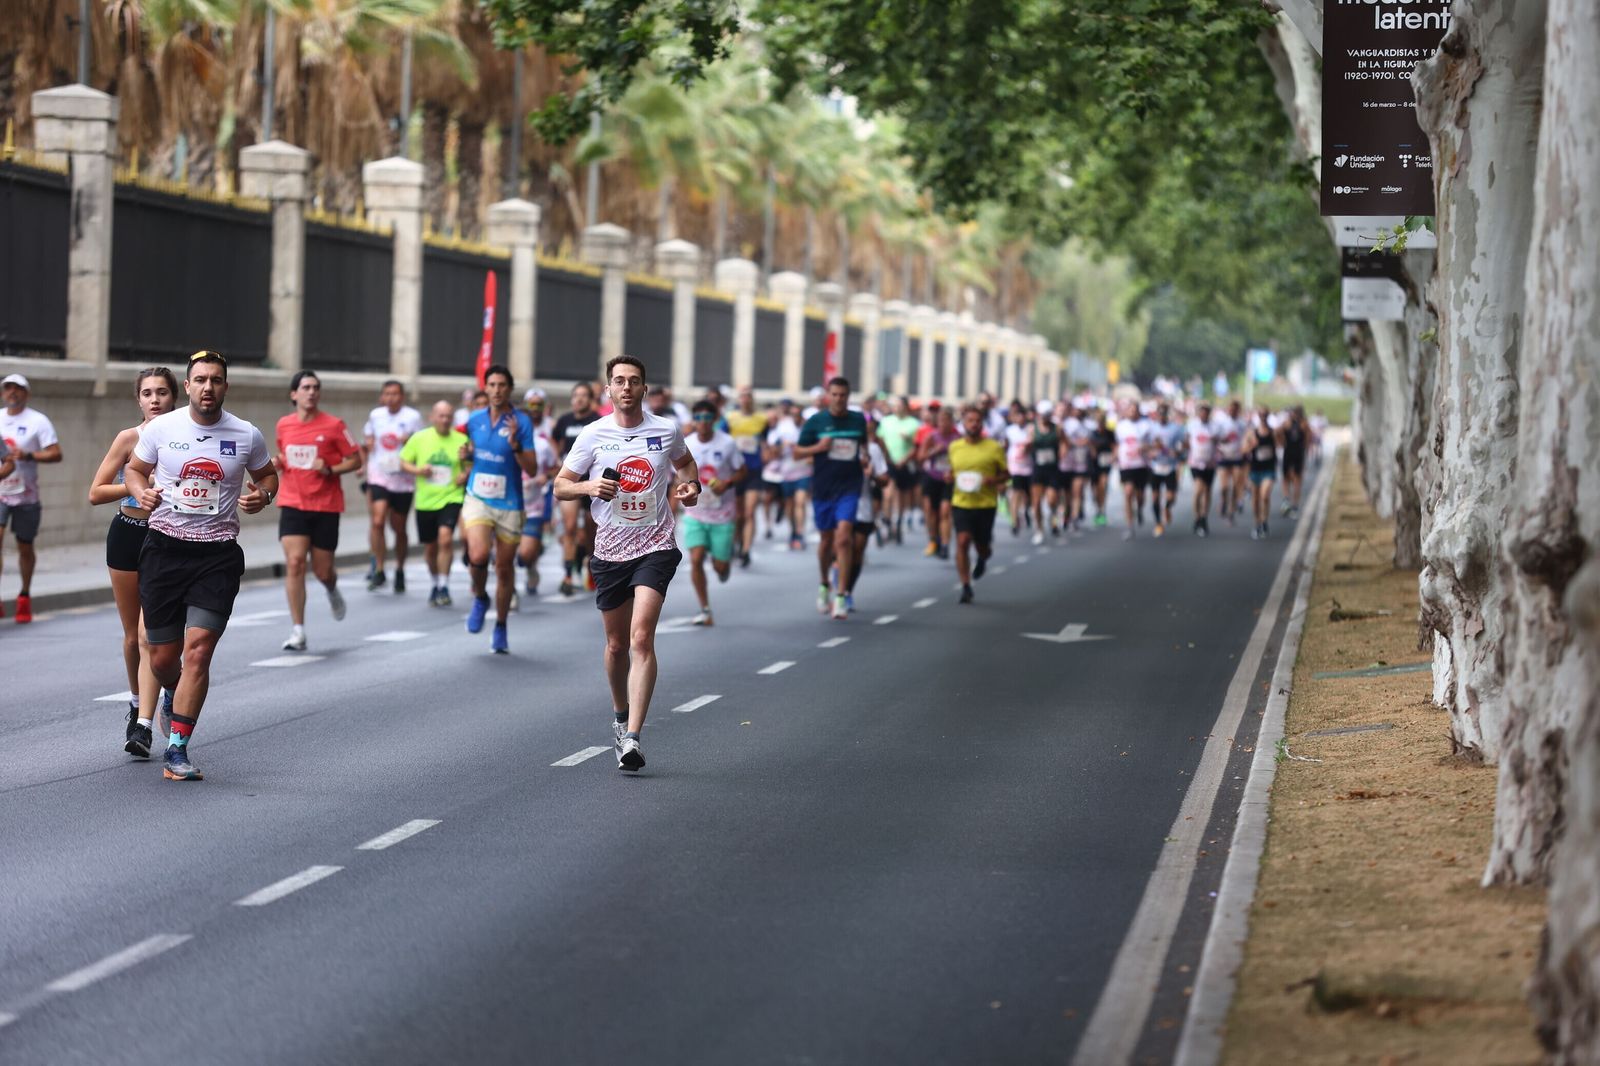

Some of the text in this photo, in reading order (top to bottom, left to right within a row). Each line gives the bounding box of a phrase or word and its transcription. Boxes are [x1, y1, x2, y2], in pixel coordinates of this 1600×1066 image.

[1347, 49, 1419, 57] VANGUARDISTAS
[1422, 49, 1428, 57] Y
[1344, 72, 1395, 80] (1920-1970).
[1350, 154, 1385, 162] Fundación
[1350, 161, 1375, 170] Unicaja
[188, 465, 220, 480] PONLE
[621, 465, 650, 478] PONLE
[620, 473, 648, 485] FRENO
[183, 488, 208, 498] 607
[621, 501, 647, 511] 519
[120, 514, 147, 527] NIKE
